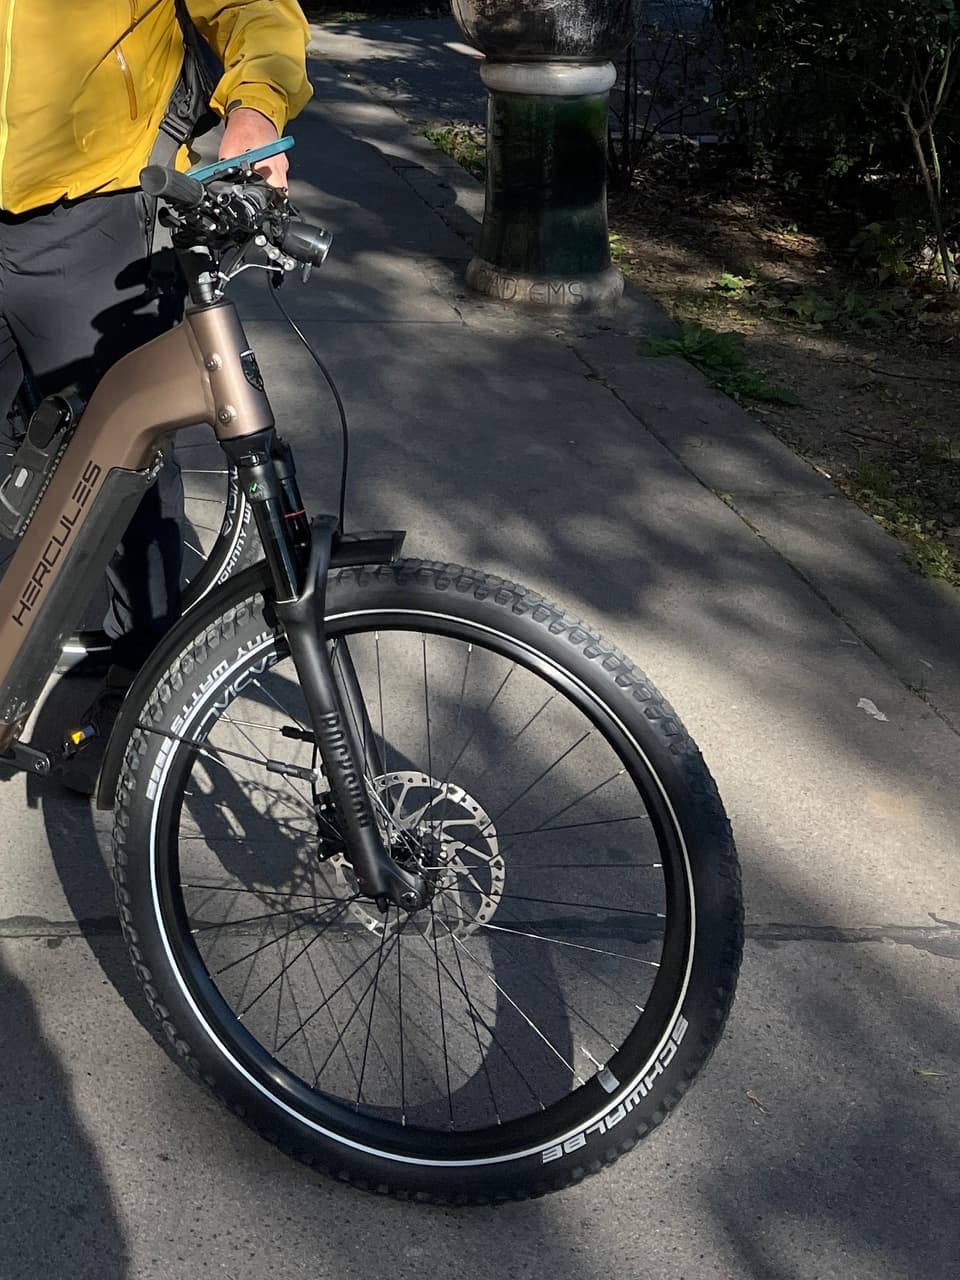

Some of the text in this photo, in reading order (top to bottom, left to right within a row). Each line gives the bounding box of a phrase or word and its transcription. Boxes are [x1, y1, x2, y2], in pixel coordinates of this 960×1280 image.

[12, 461, 102, 626] HERCULES
[170, 631, 275, 734] NNY WATTS
[542, 1014, 689, 1164] SCHWALBE
